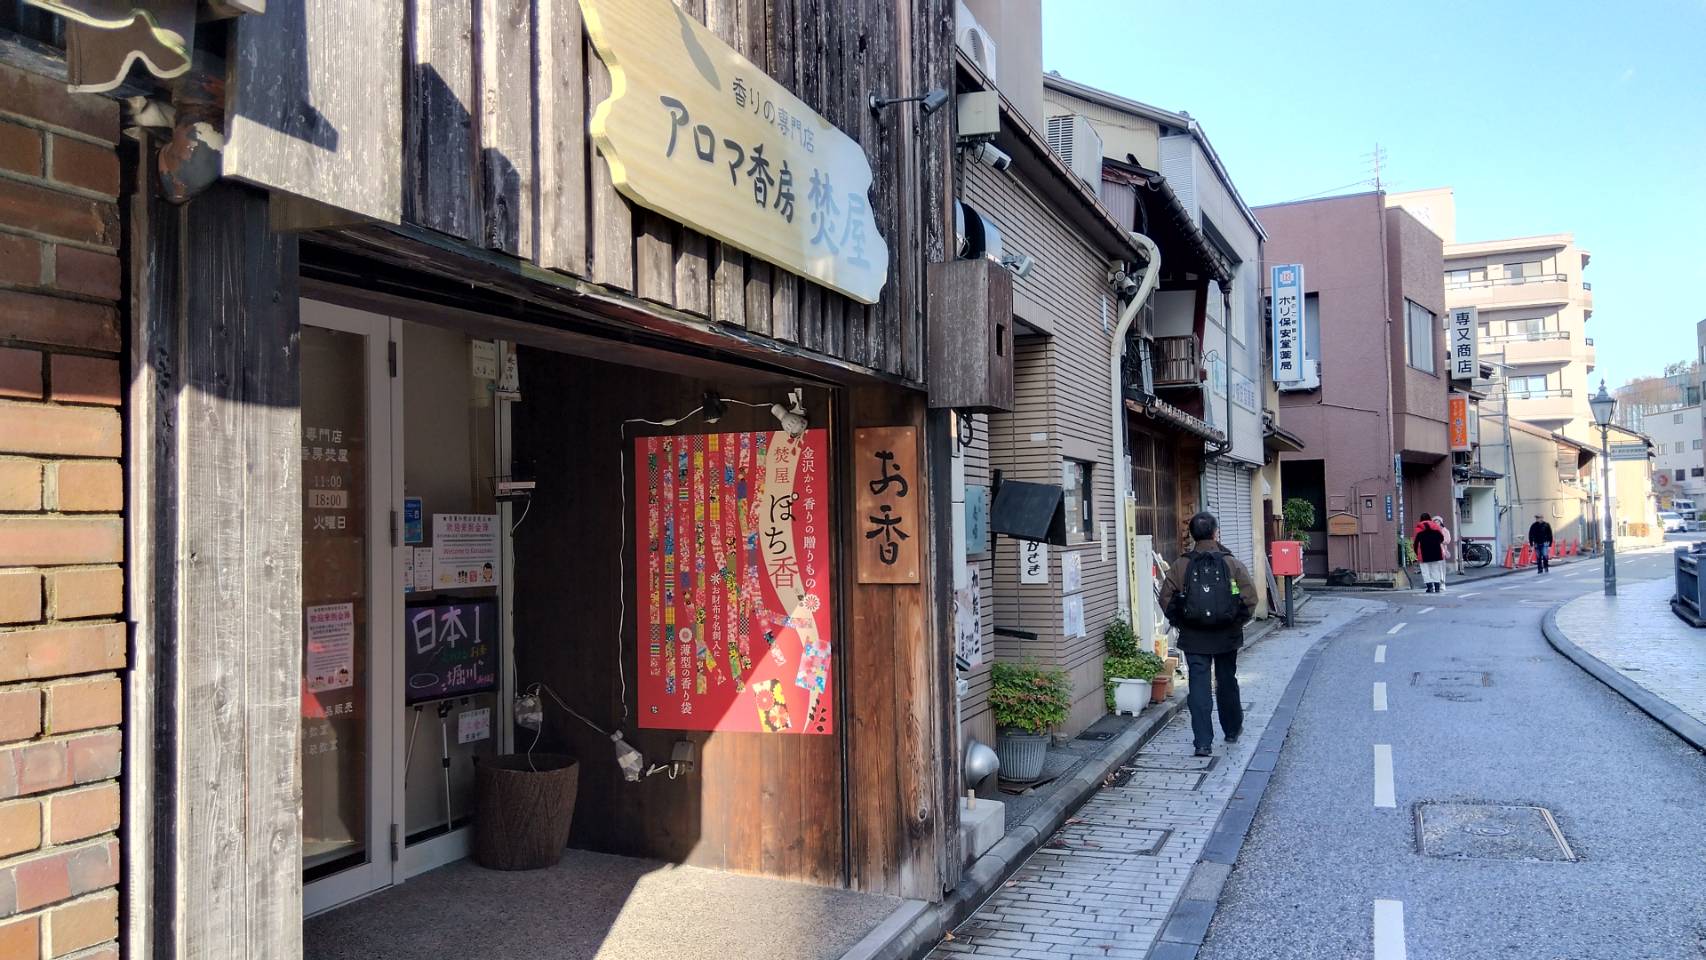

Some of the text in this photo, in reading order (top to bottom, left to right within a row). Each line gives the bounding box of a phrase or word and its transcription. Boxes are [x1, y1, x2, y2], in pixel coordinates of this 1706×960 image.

[732, 77, 815, 153] 香りの専門店
[660, 95, 871, 270] アロマ香房 焚屋
[1279, 296, 1292, 371] ホリ保安堂薬局
[1456, 312, 1471, 373] 専又商店
[315, 494, 342, 506] 18:00
[774, 446, 790, 484] 焚屋
[313, 515, 346, 530] 火曜日
[765, 492, 799, 589] ぽち香
[802, 447, 816, 588] 金沢から香りの贈りもの
[866, 451, 910, 565] お香
[680, 644, 692, 714] 薄型の香り袋
